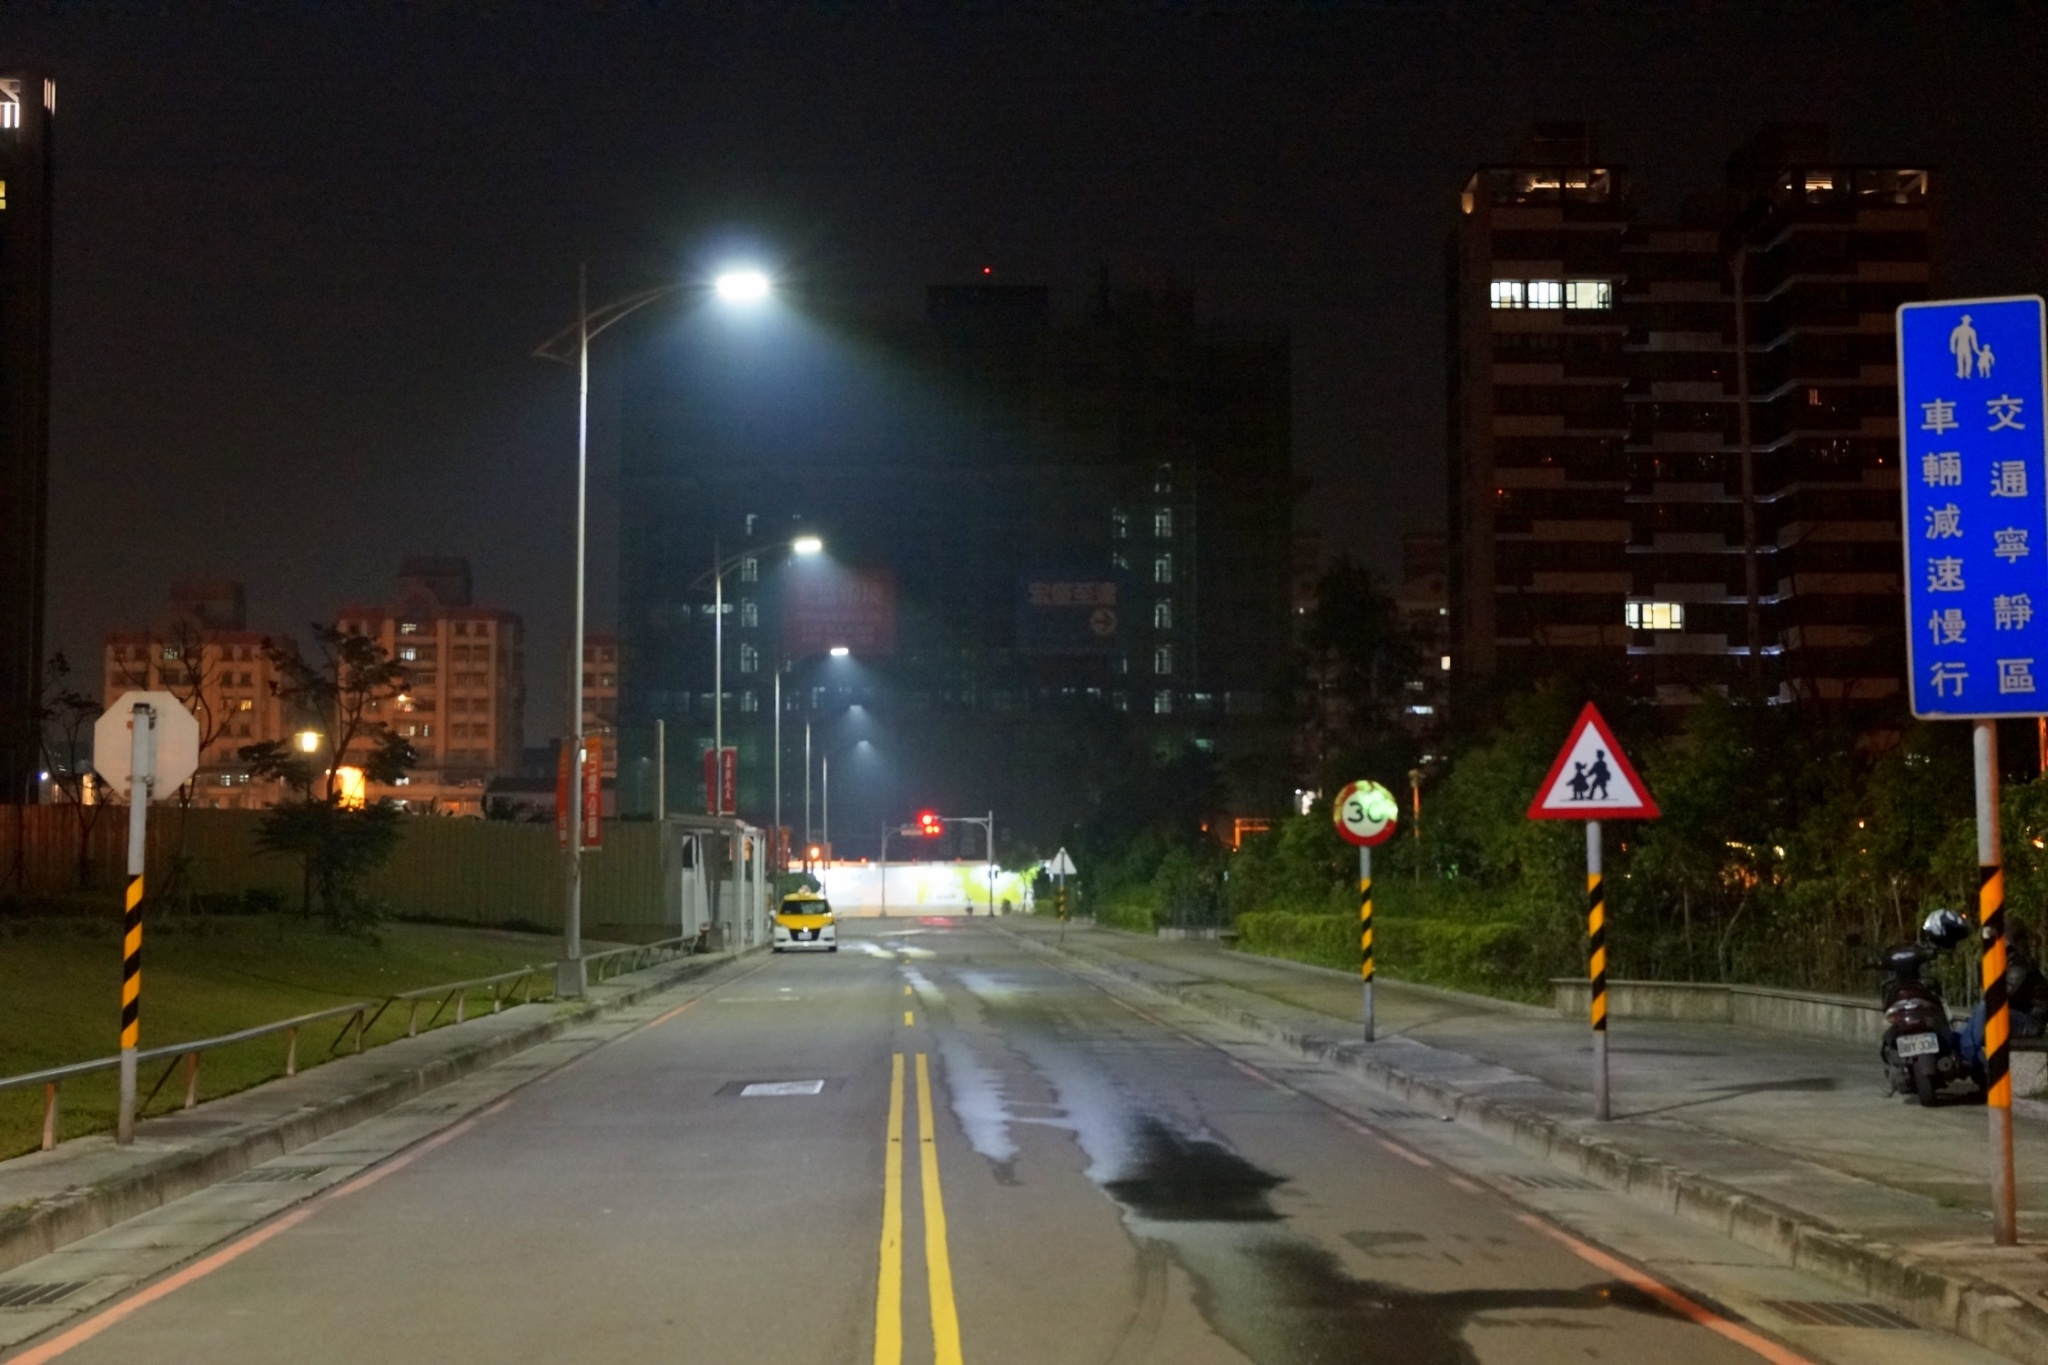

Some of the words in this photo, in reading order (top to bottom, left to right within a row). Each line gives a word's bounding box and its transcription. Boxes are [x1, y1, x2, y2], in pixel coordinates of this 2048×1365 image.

[1921, 398, 1969, 698] 車輛減速慢行
[1986, 394, 2036, 694] 交通寧靜區
